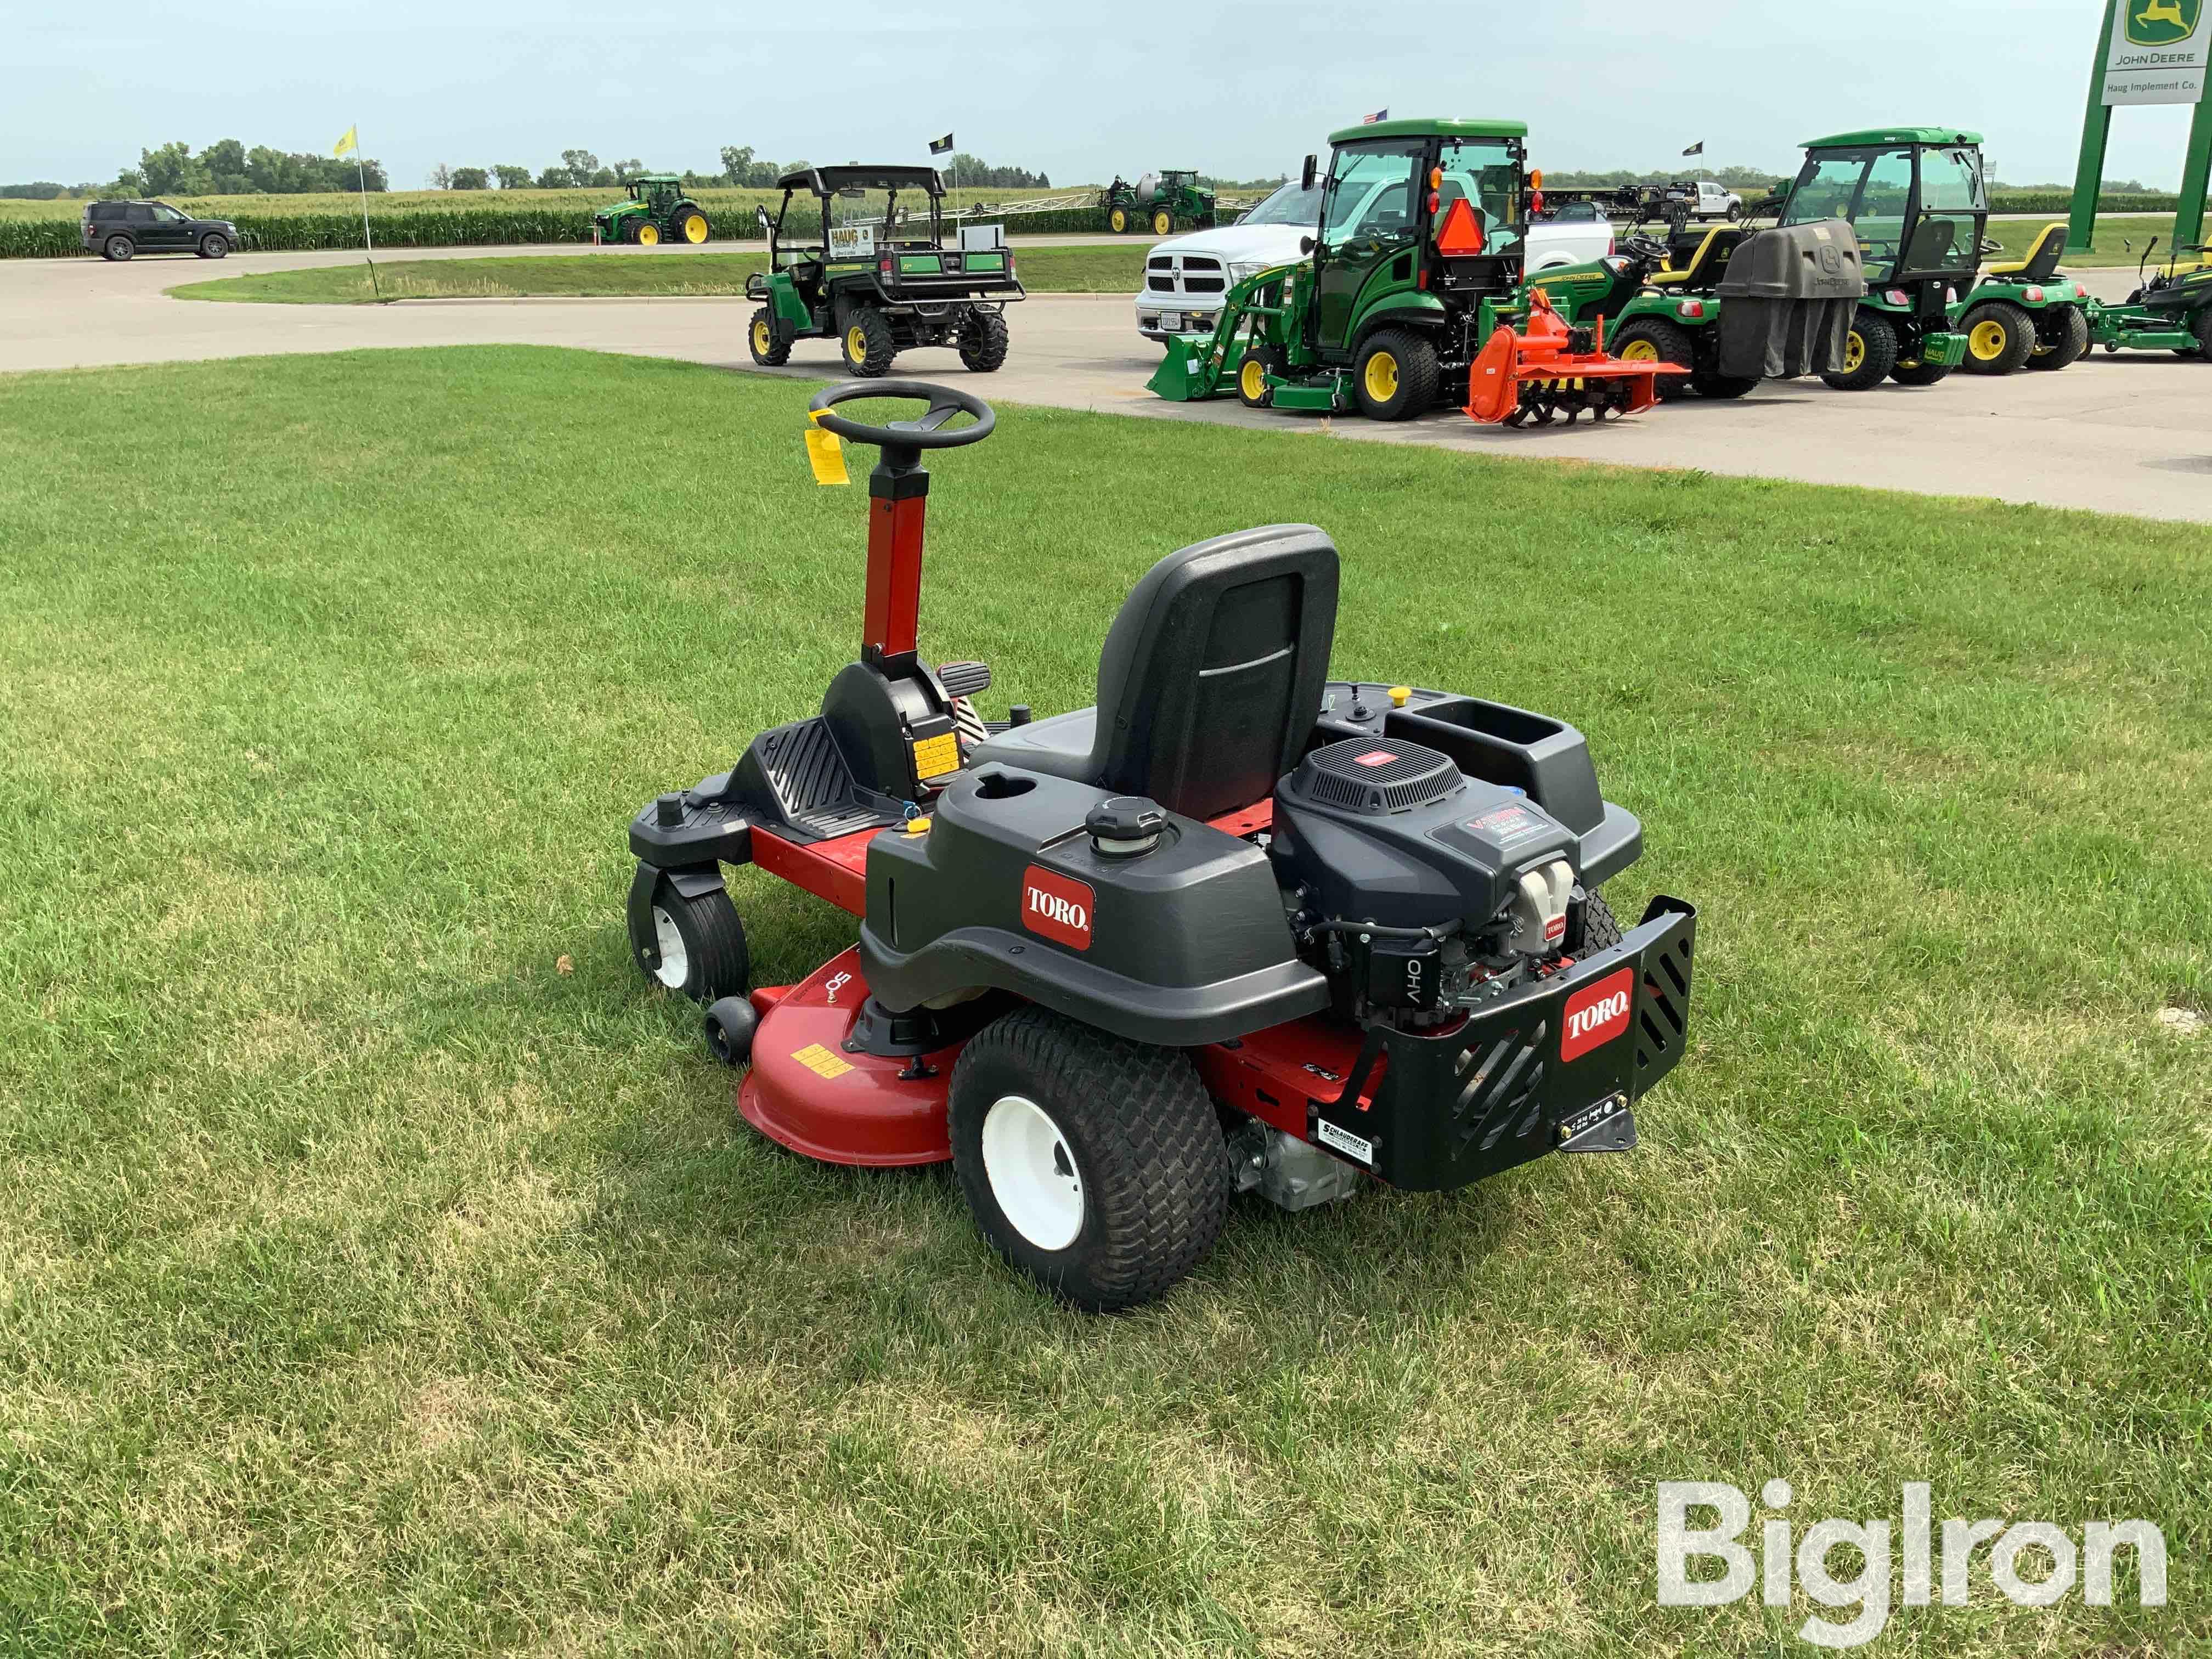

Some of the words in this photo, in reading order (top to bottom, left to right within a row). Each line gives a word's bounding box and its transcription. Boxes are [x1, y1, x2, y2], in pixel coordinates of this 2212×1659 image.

[2115, 55, 2148, 65] JOHN
[2150, 53, 2195, 64] DEERE
[2107, 84, 2128, 93] Haug
[2131, 82, 2179, 92] Implement
[2182, 81, 2197, 89] Co.
[831, 229, 858, 245] HAUG
[1925, 347, 1944, 358] HAUG
[1028, 887, 1086, 929] TORO
[1547, 922, 1564, 934] TORO
[1407, 960, 1421, 1004] OHV
[1568, 991, 1627, 1040] TORO
[1323, 1124, 1369, 1148] SCHLAUDERAFF
